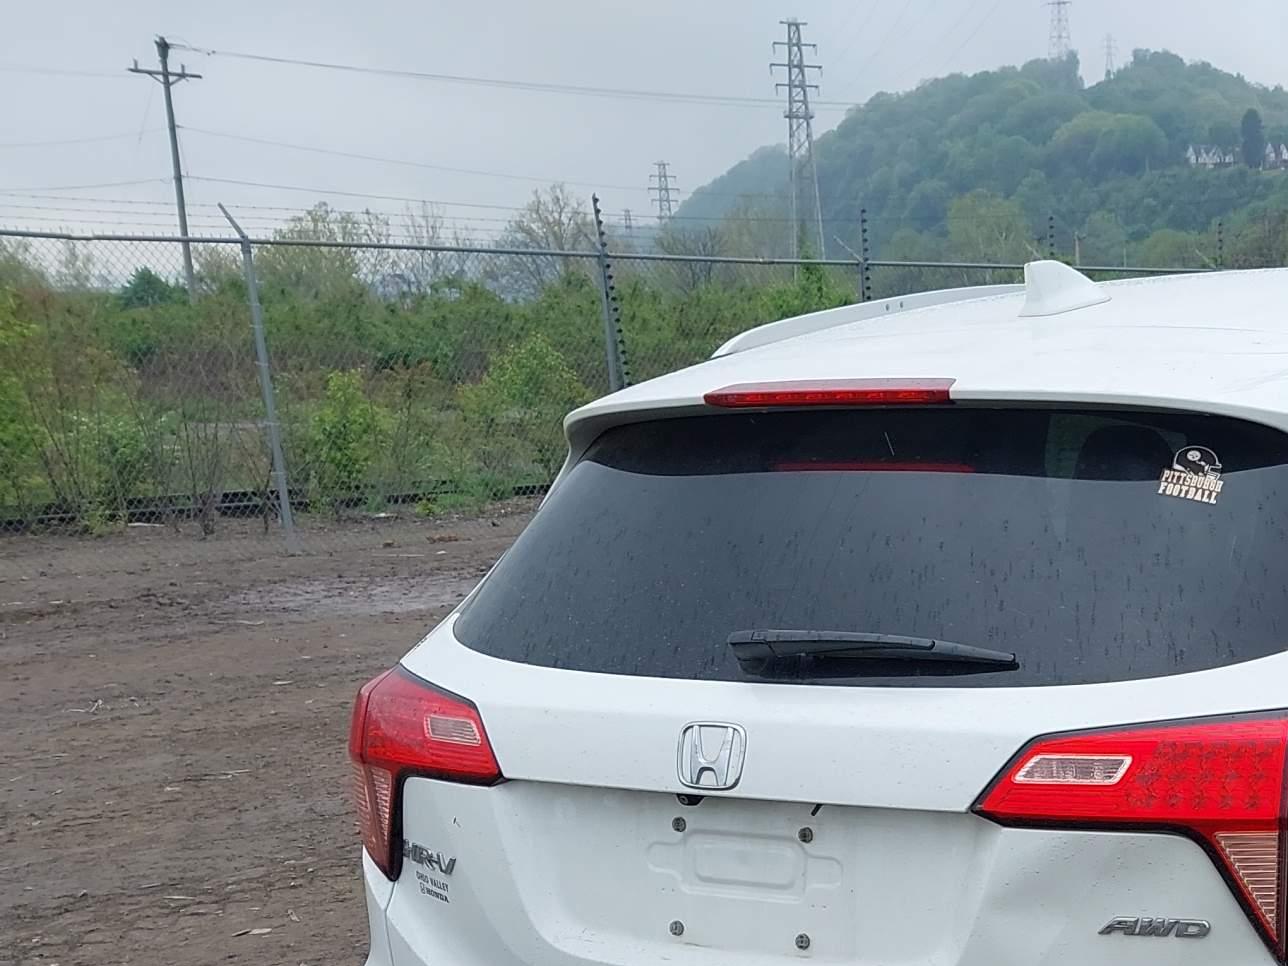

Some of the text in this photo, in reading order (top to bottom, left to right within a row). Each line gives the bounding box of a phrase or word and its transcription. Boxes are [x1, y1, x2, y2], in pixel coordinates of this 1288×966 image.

[1161, 469, 1224, 492] PITTSBURGH
[1158, 481, 1217, 505] FOOTBALL
[425, 887, 450, 904] HONDA
[429, 877, 449, 893] VALLEY
[1097, 915, 1212, 939] AWD
